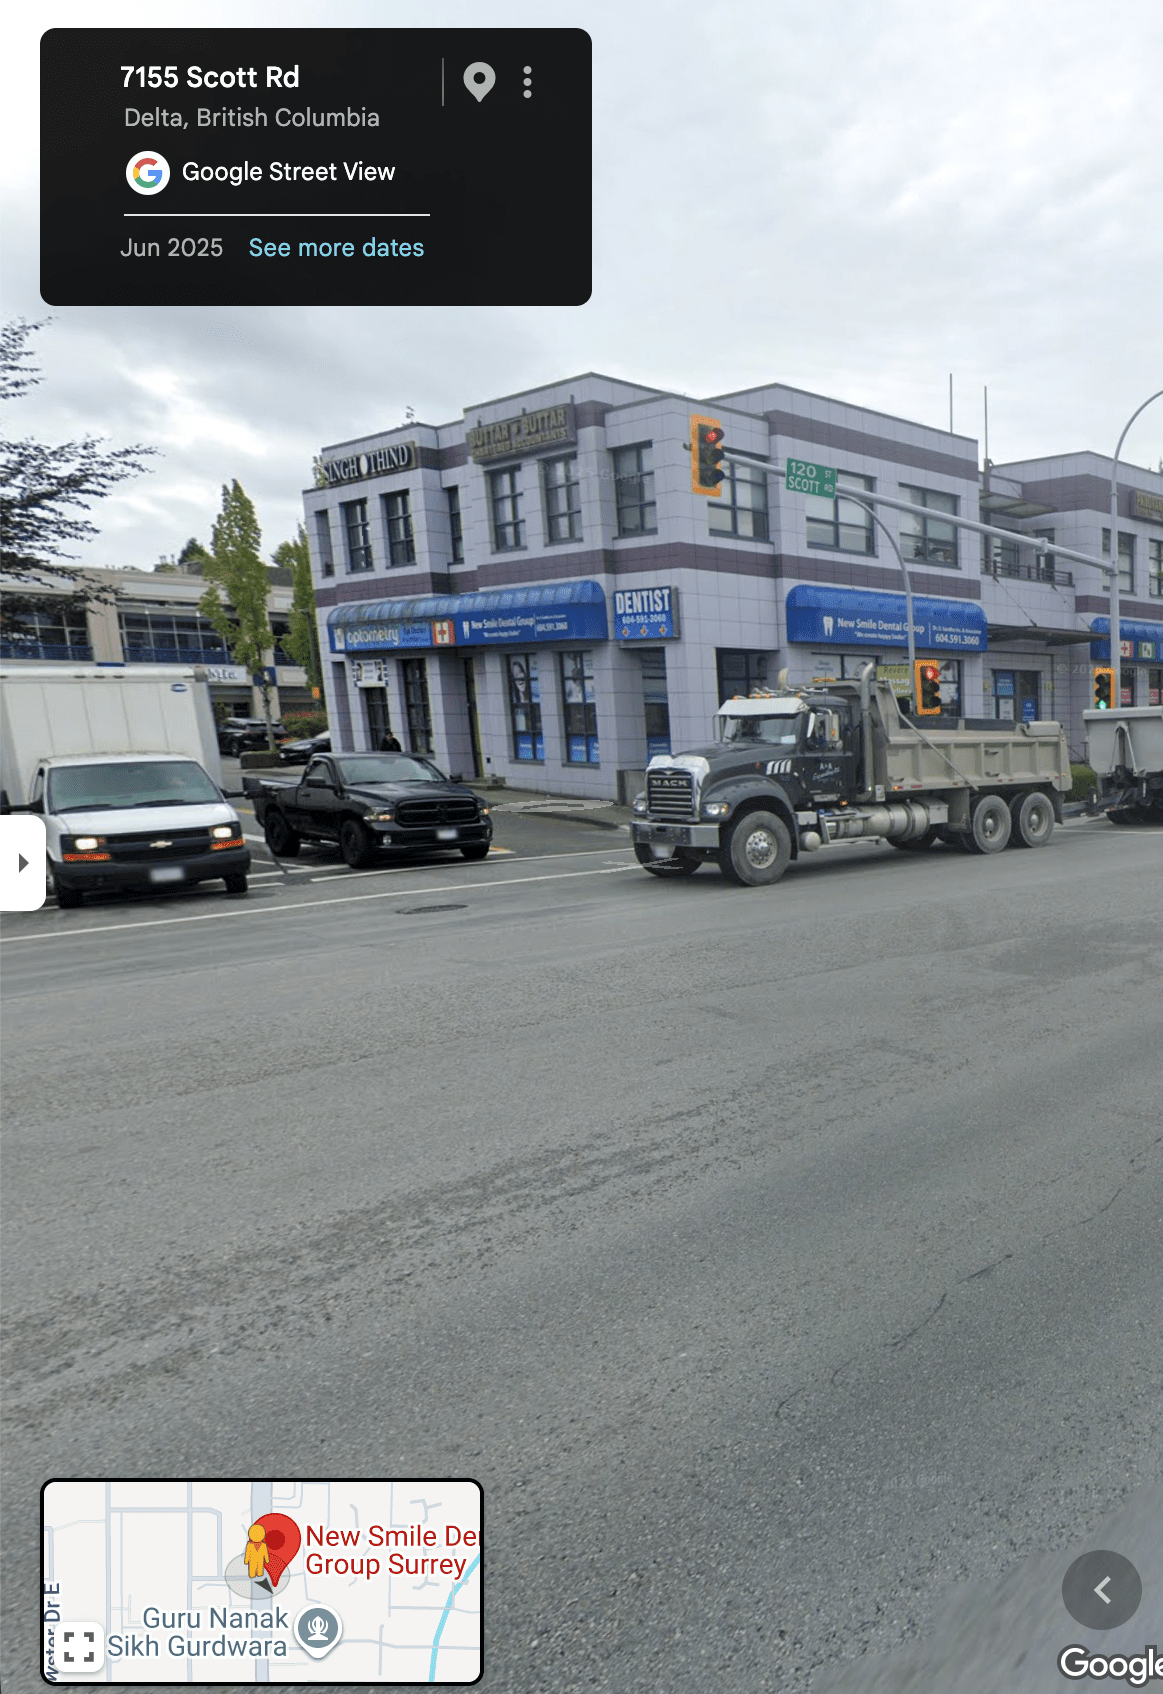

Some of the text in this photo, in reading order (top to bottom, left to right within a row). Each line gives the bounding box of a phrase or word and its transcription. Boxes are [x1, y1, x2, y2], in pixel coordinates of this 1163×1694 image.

[471, 423, 510, 449] BUTTAR
[523, 409, 566, 434] BUTTAR
[323, 444, 409, 482] SINGH THIND
[790, 461, 833, 478] 120 ST
[788, 476, 834, 494] SCOTT RD
[615, 588, 670, 614] DENTIST
[837, 618, 855, 628] New
[856, 618, 877, 629] Smile
[878, 620, 902, 631] Dental
[903, 622, 925, 635] Goup
[346, 627, 400, 648] optometry
[935, 633, 980, 646] 604.591.3060
[651, 779, 688, 787] MACK
